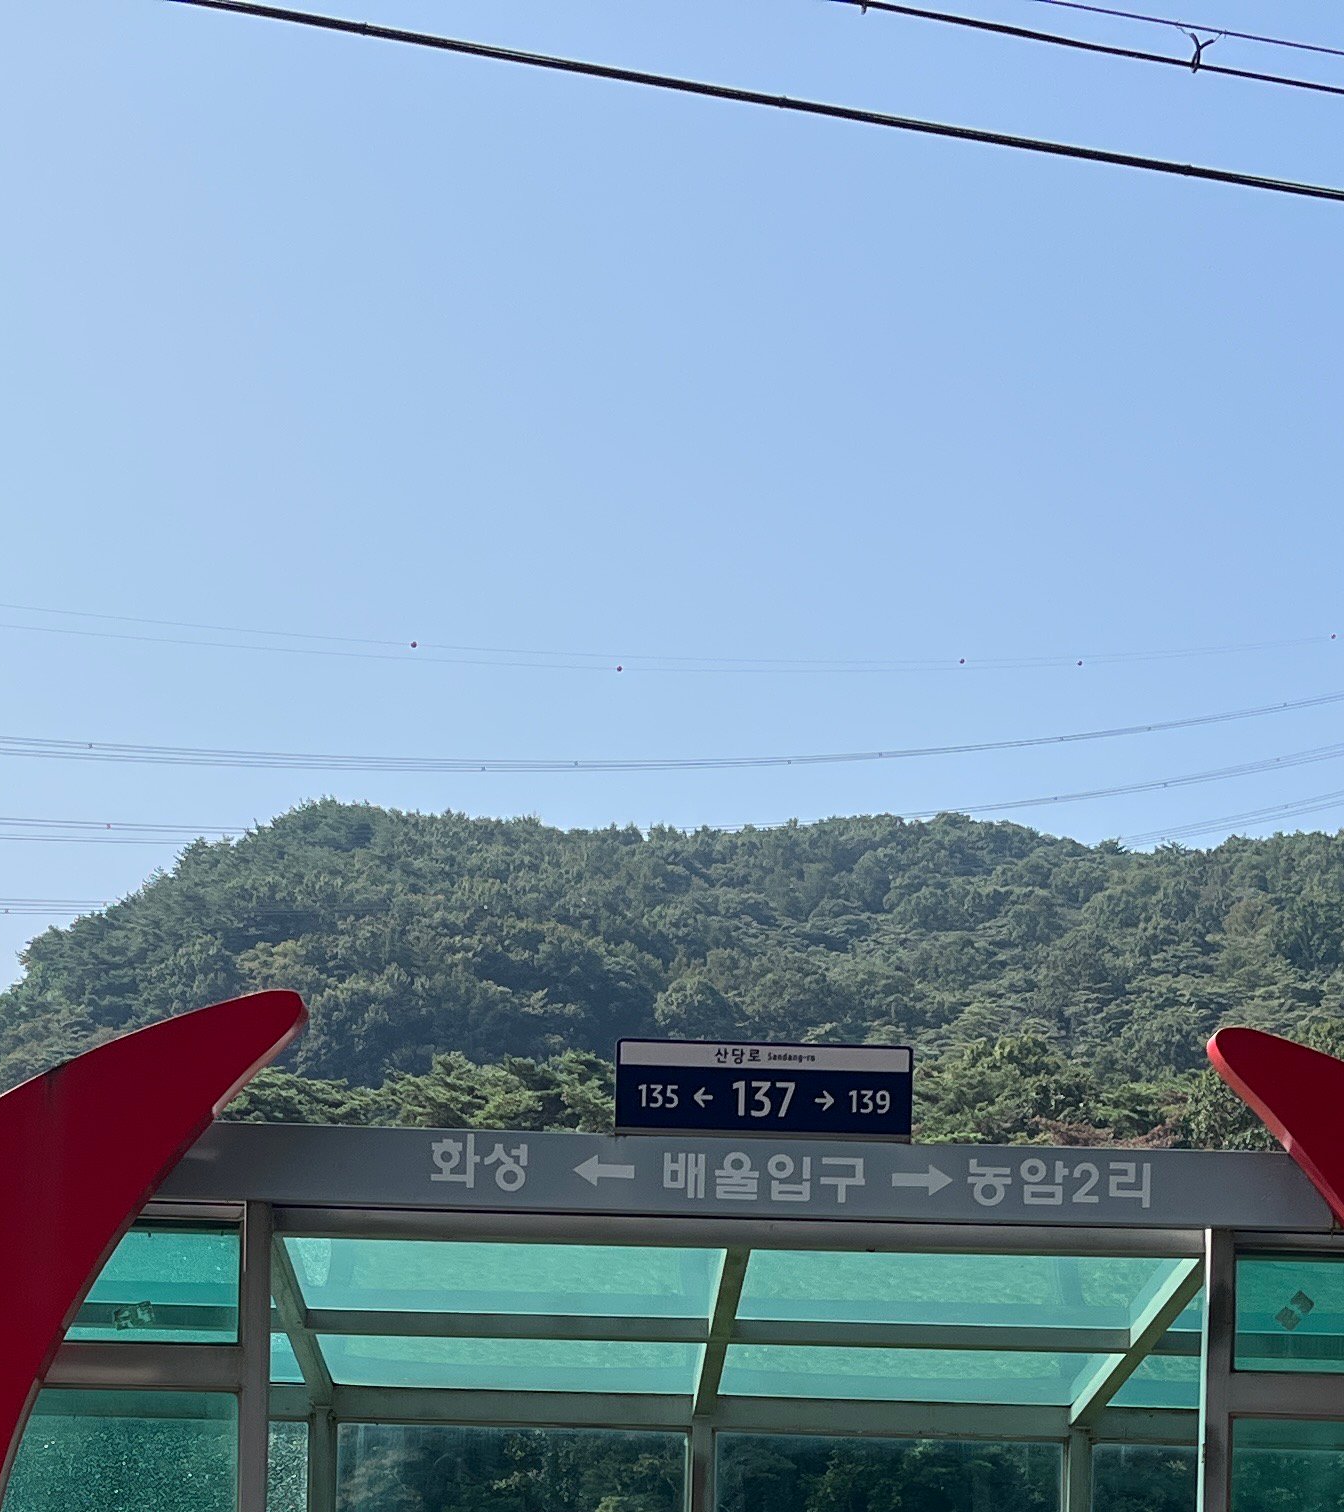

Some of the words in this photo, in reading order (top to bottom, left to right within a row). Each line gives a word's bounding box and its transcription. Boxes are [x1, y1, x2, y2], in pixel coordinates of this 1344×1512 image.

[714, 1047, 762, 1065] 산당로
[767, 1052, 816, 1063] Sandang-ro
[637, 1083, 680, 1109] 135
[732, 1079, 797, 1118] 137
[848, 1089, 892, 1115] 139
[429, 1133, 530, 1193] 화성
[661, 1150, 867, 1204] 배울입구
[966, 1157, 1154, 1209] 농암2리
